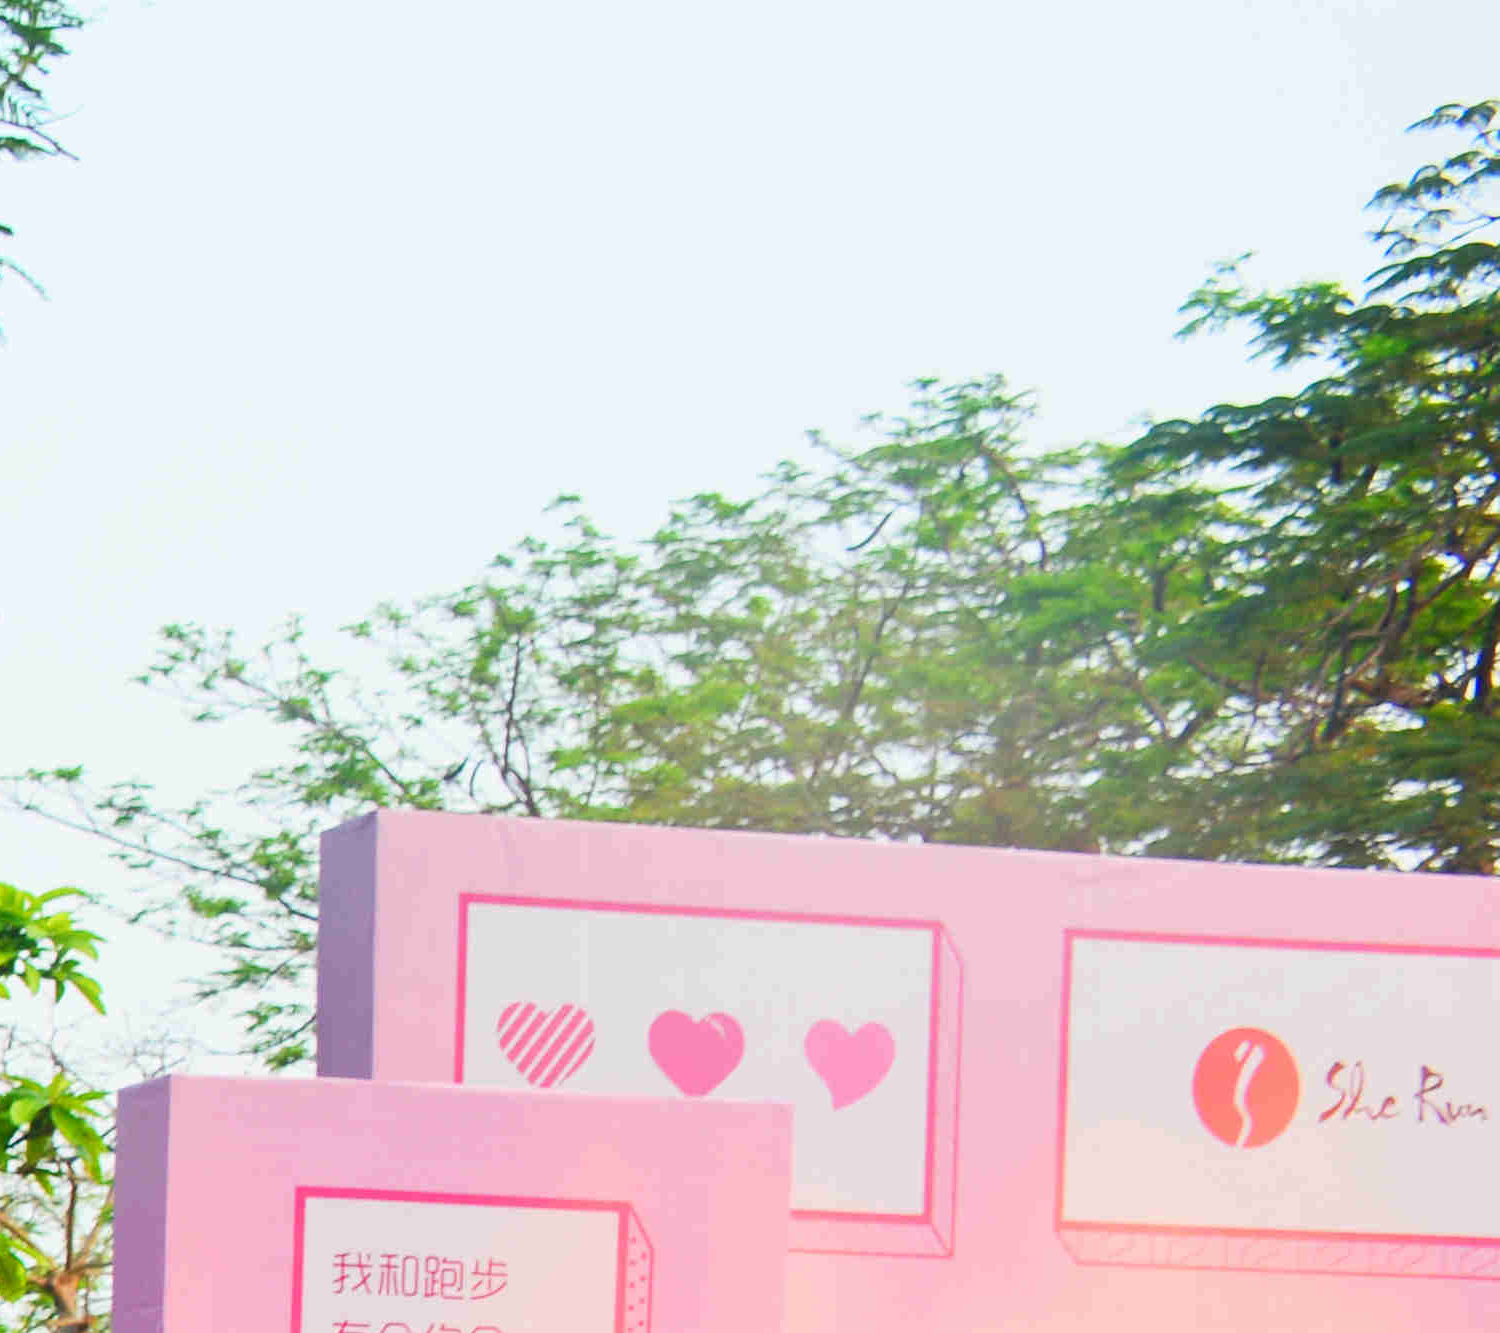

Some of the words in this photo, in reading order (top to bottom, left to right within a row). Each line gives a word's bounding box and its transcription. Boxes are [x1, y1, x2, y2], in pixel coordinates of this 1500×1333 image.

[1318, 1061, 1399, 1123] She
[1414, 1064, 1489, 1126] Run
[332, 1252, 508, 1300] 我和跑步
